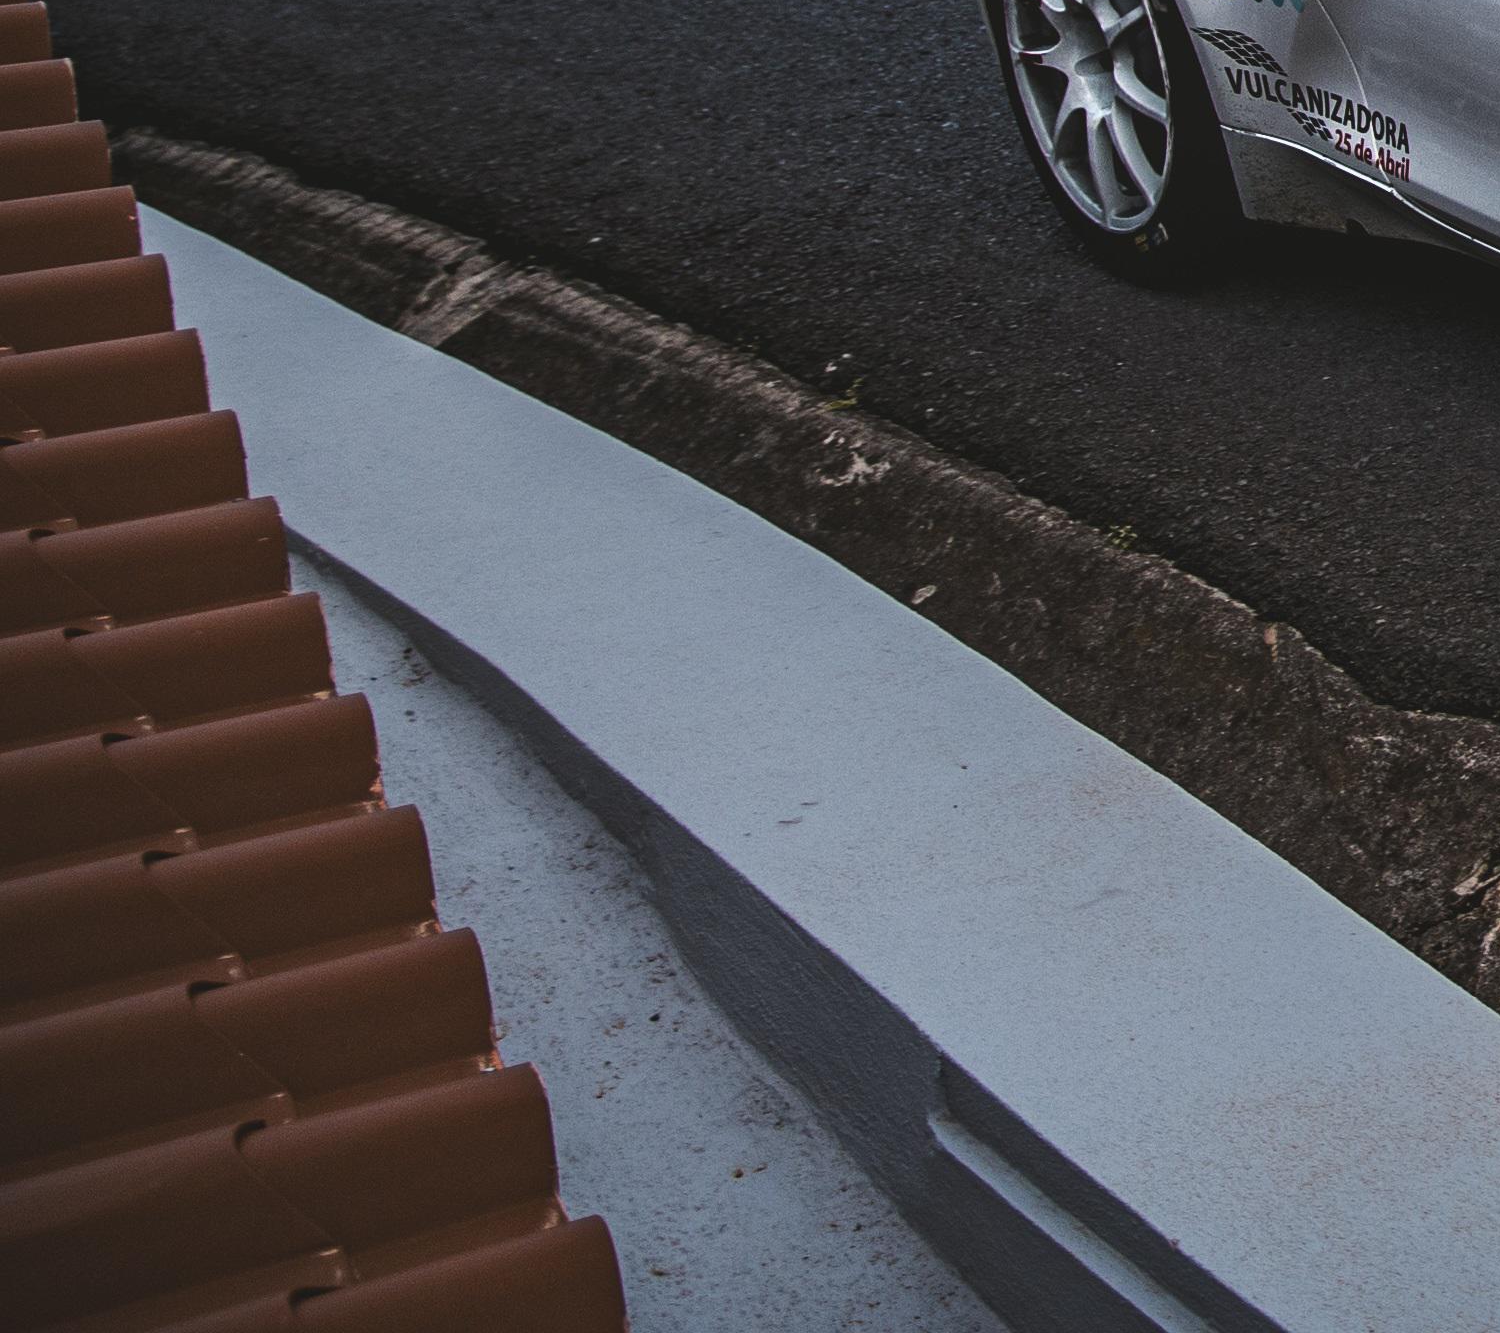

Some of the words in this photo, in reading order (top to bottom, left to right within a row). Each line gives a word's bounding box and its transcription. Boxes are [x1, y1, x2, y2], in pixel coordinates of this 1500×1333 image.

[1223, 66, 1411, 154] VULCANIZADORA
[1334, 129, 1352, 155] 25
[1354, 139, 1374, 167] de
[1375, 146, 1411, 182] Abril
